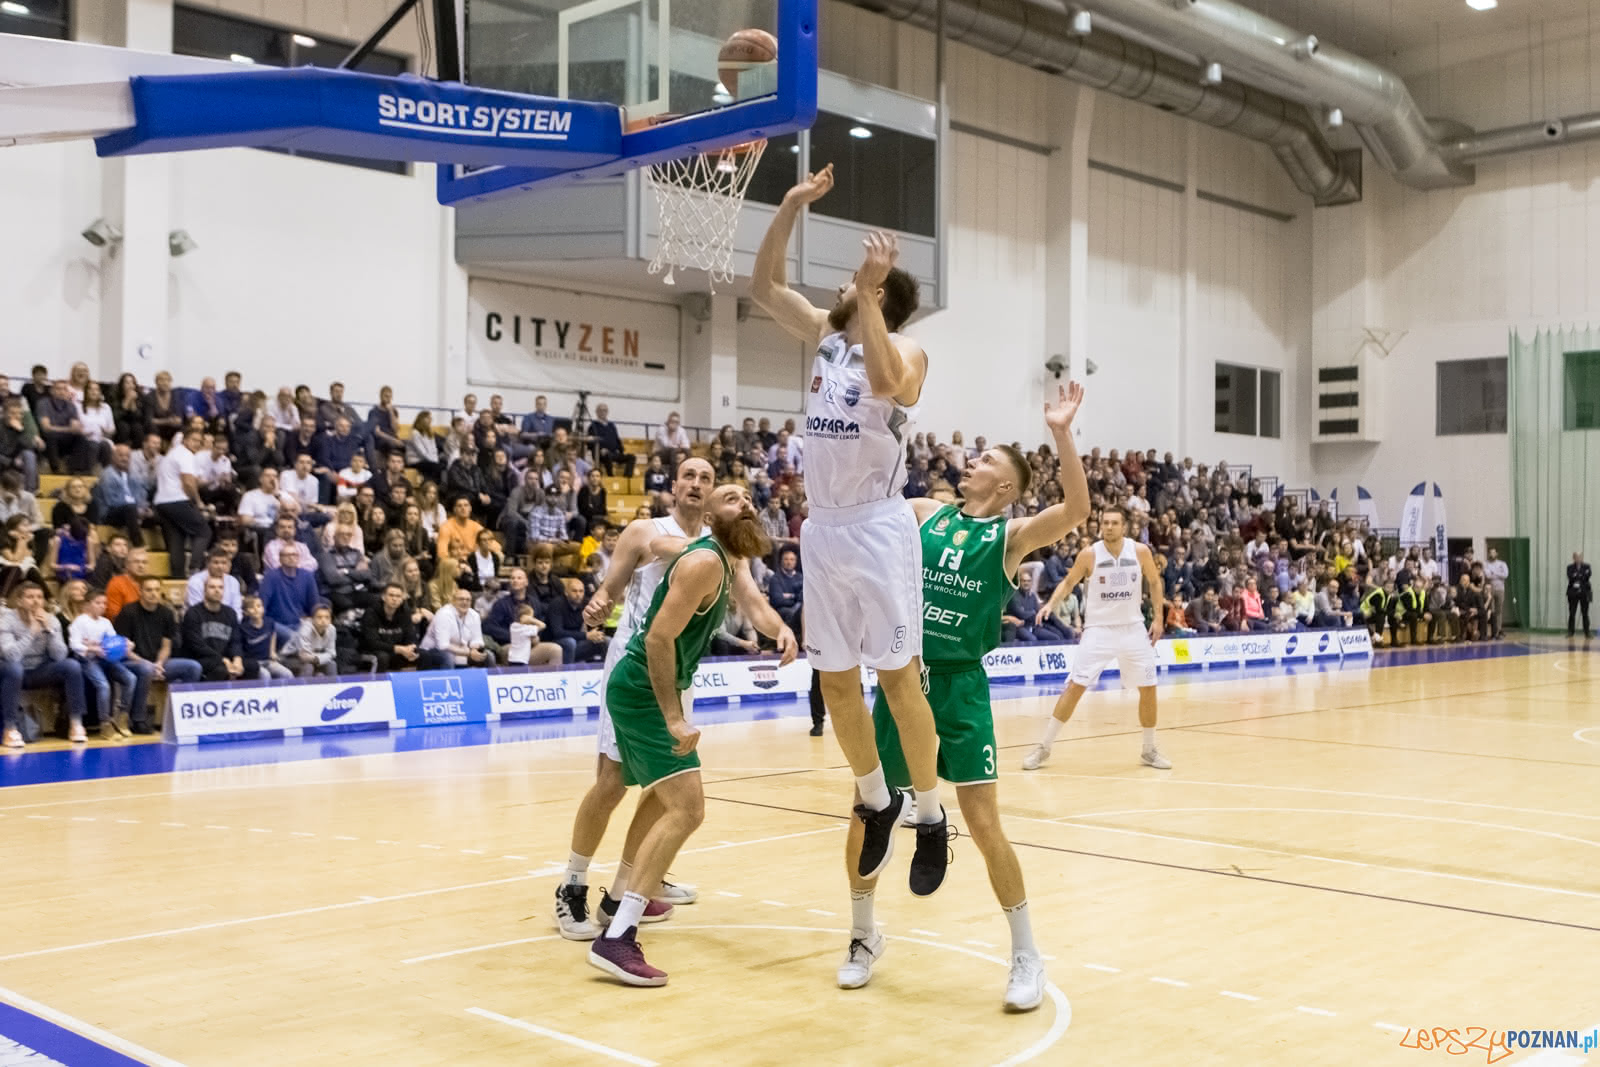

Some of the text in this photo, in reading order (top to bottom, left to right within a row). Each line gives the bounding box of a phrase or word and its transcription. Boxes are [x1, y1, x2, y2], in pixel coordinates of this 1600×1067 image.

[378, 94, 572, 135] SPORT SYSTEM
[485, 311, 640, 357] CITYZEN
[981, 523, 999, 542] 3
[922, 566, 983, 594] tureNet
[933, 584, 969, 598] WROCŁAW
[891, 625, 906, 654] 8
[1046, 652, 1067, 670] PBG
[181, 699, 279, 719] BIOFARM
[423, 702, 466, 717] HOTEL
[983, 744, 995, 775] 3
